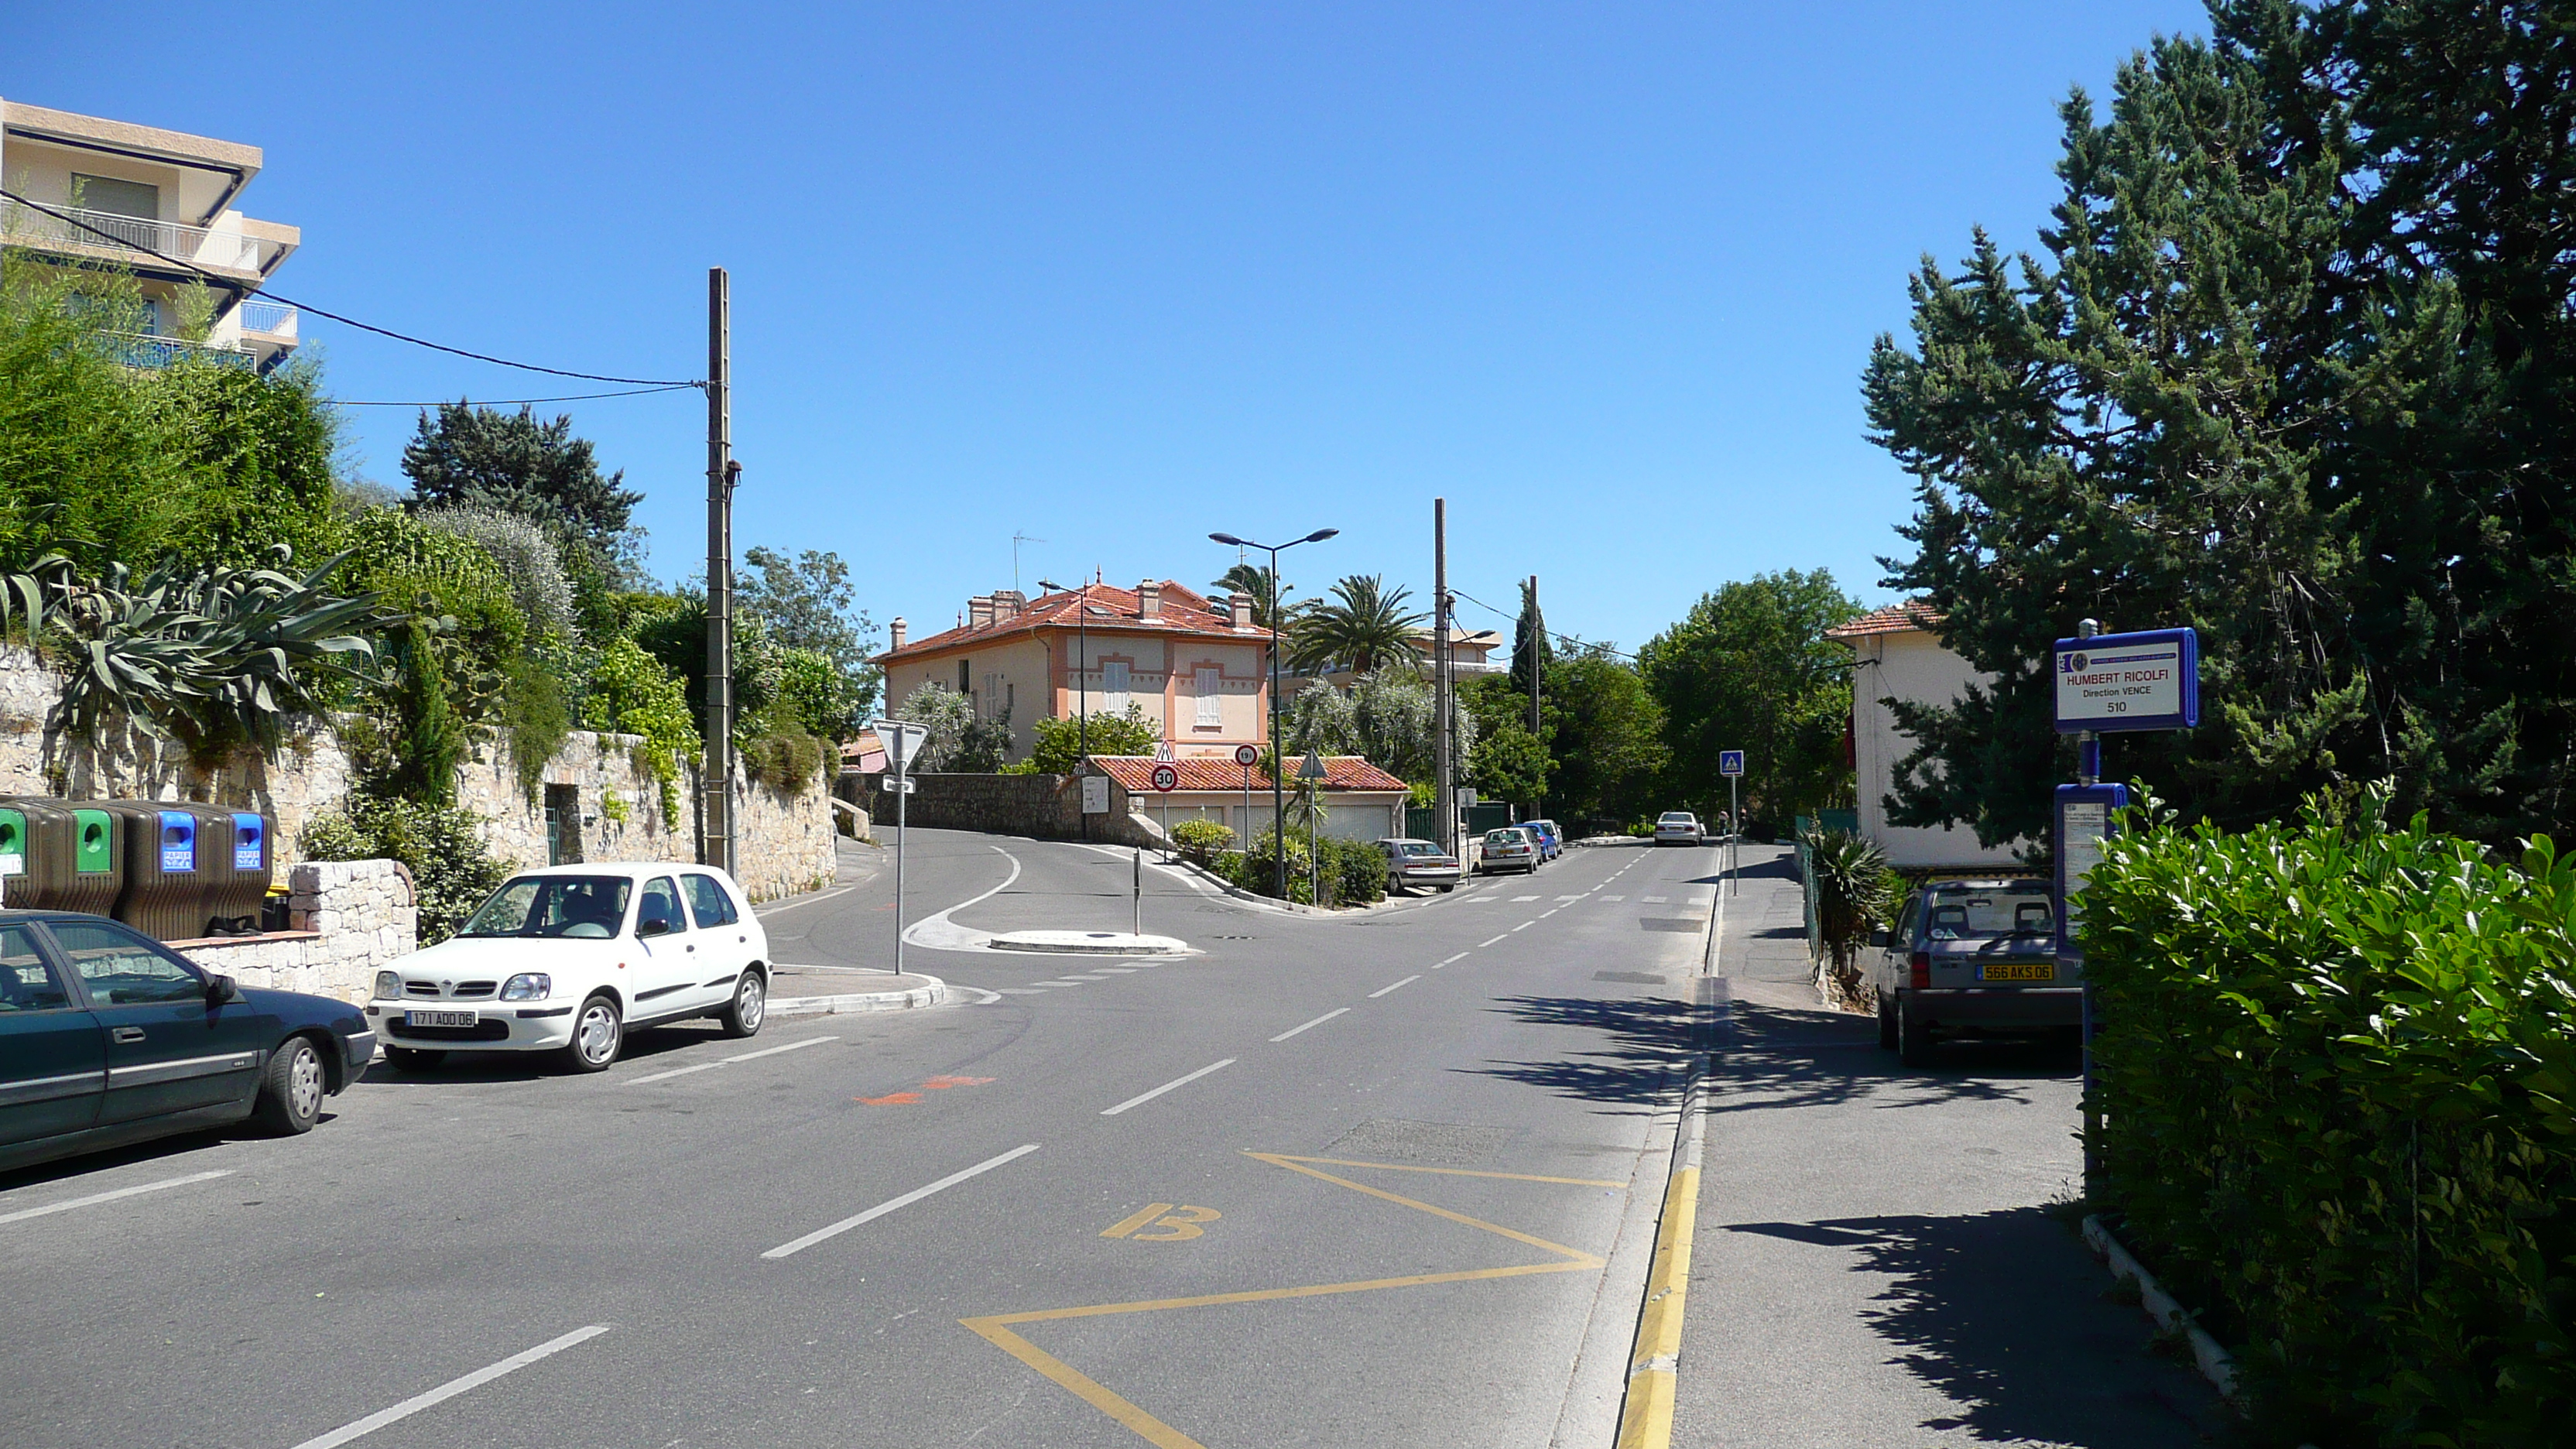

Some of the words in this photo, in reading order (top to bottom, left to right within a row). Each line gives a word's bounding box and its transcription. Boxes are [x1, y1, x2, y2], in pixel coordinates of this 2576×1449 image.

[2067, 672, 2120, 686] HUMBERT
[2124, 669, 2169, 682] RICOLFI
[2083, 688, 2119, 698] Direction
[2122, 686, 2152, 695] VENCE
[2107, 701, 2127, 713] 510
[1156, 773, 1173, 785] 30
[1985, 965, 2008, 979] 566
[2011, 965, 2033, 979] AKS
[2034, 965, 2050, 978] 06
[415, 1012, 432, 1025] 171
[458, 1013, 473, 1026] 06
